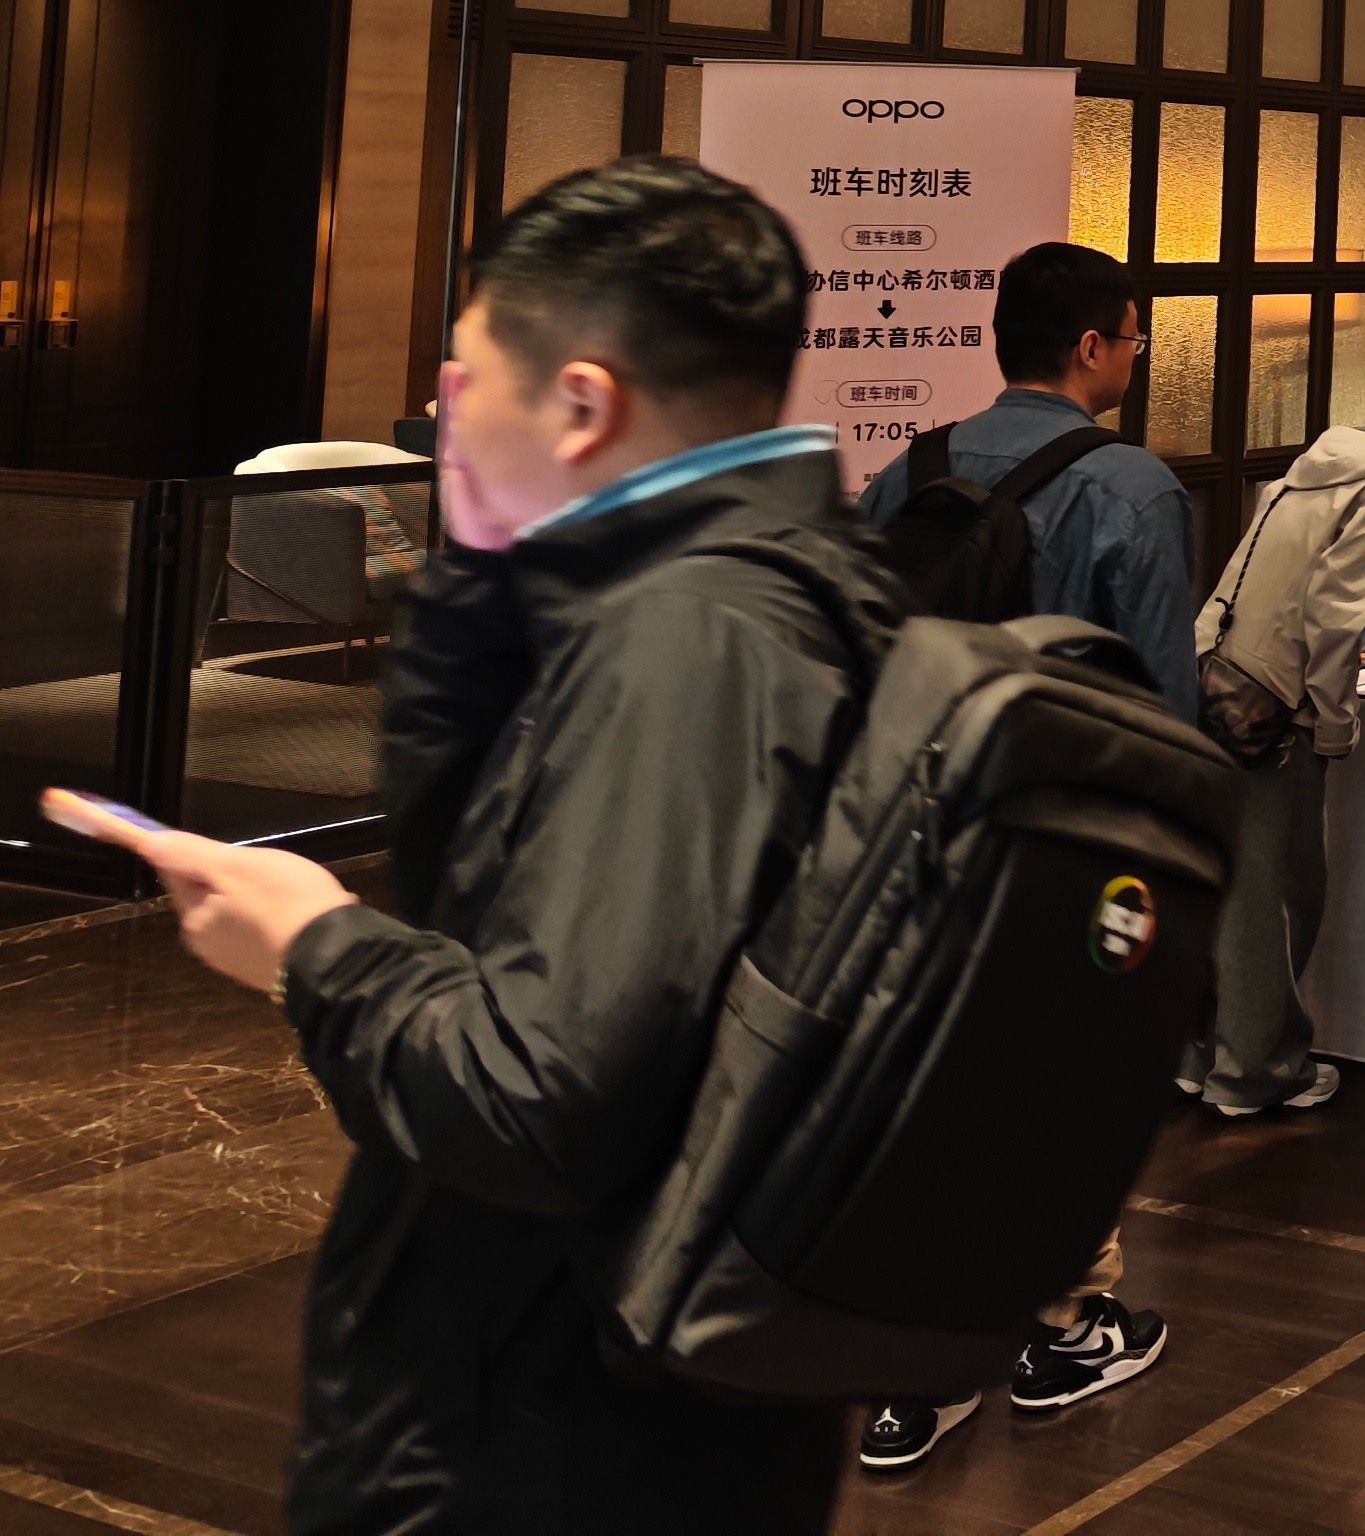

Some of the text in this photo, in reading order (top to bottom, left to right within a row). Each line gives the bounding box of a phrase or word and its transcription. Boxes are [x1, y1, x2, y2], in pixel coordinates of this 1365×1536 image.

[810, 167, 972, 198] 班车时刻表
[855, 229, 923, 246] 班车线路
[808, 269, 1002, 293] 协信中心希尔顿酒
[850, 385, 918, 402] 班车时间
[853, 421, 918, 442] 17:05
